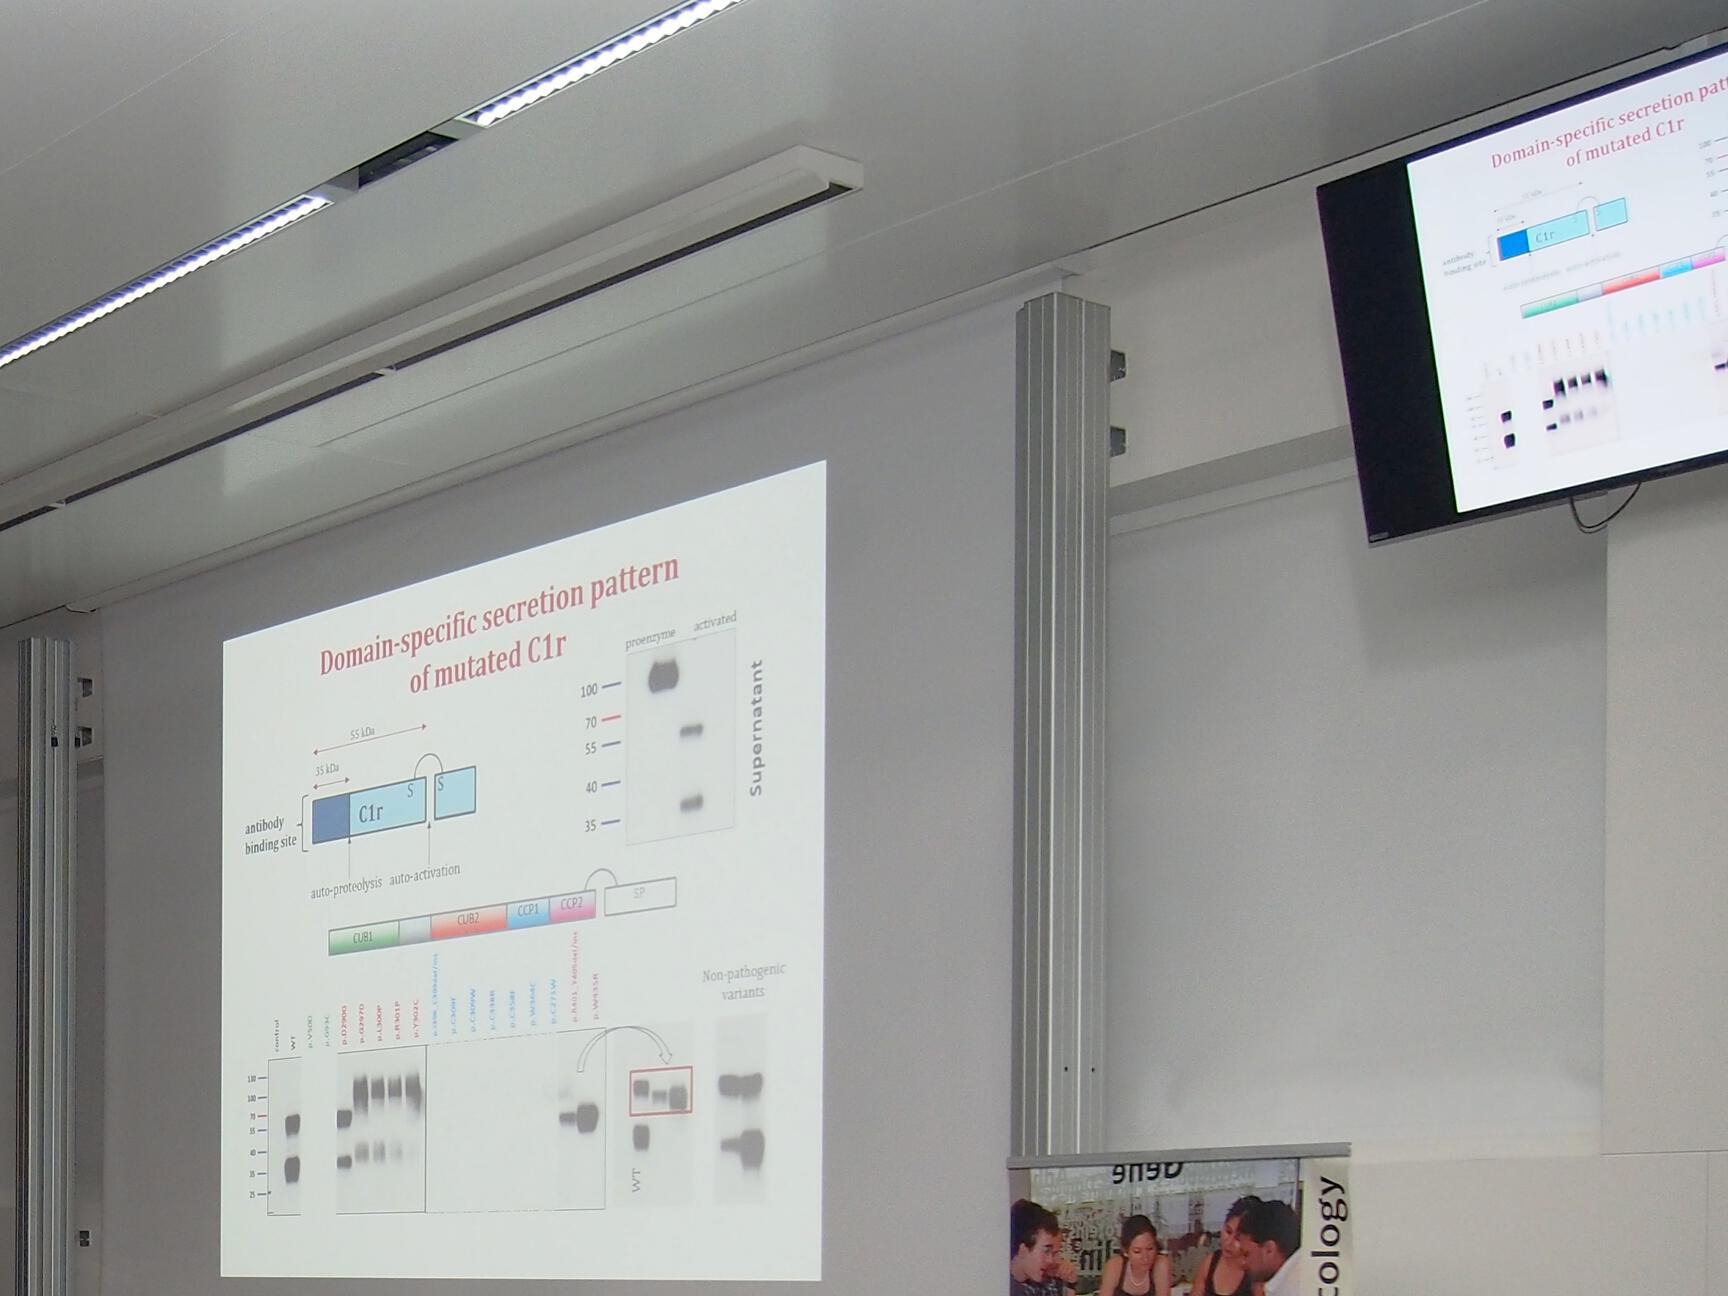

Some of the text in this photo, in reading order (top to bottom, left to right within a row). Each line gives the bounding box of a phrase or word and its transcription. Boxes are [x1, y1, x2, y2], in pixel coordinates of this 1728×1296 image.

[1491, 116, 1615, 169] Domain-specific
[1618, 85, 1694, 125] secretion
[1566, 117, 1685, 168] of mutated C1r
[320, 558, 680, 676] Domain-specific secretion pattern
[625, 609, 737, 651] proenzyme activated
[410, 633, 568, 694] of mutated C1r
[580, 683, 598, 699] 100
[585, 715, 598, 730] 70
[750, 659, 765, 797] Supernatant
[585, 741, 597, 755] 55
[407, 783, 414, 798] S
[437, 776, 444, 791] S
[585, 780, 598, 794] 40
[359, 804, 384, 824] C1r
[245, 815, 285, 836] antibody
[584, 819, 597, 833] 35
[245, 834, 298, 856] binding site
[310, 863, 461, 899] auto-proteolysis auto-activation
[517, 902, 540, 917] CCP1
[560, 895, 584, 911] CCP2
[352, 930, 373, 945] CUB1
[702, 963, 788, 983] Non-pathogenic
[721, 986, 765, 1001] variants
[632, 1168, 641, 1193] WT
